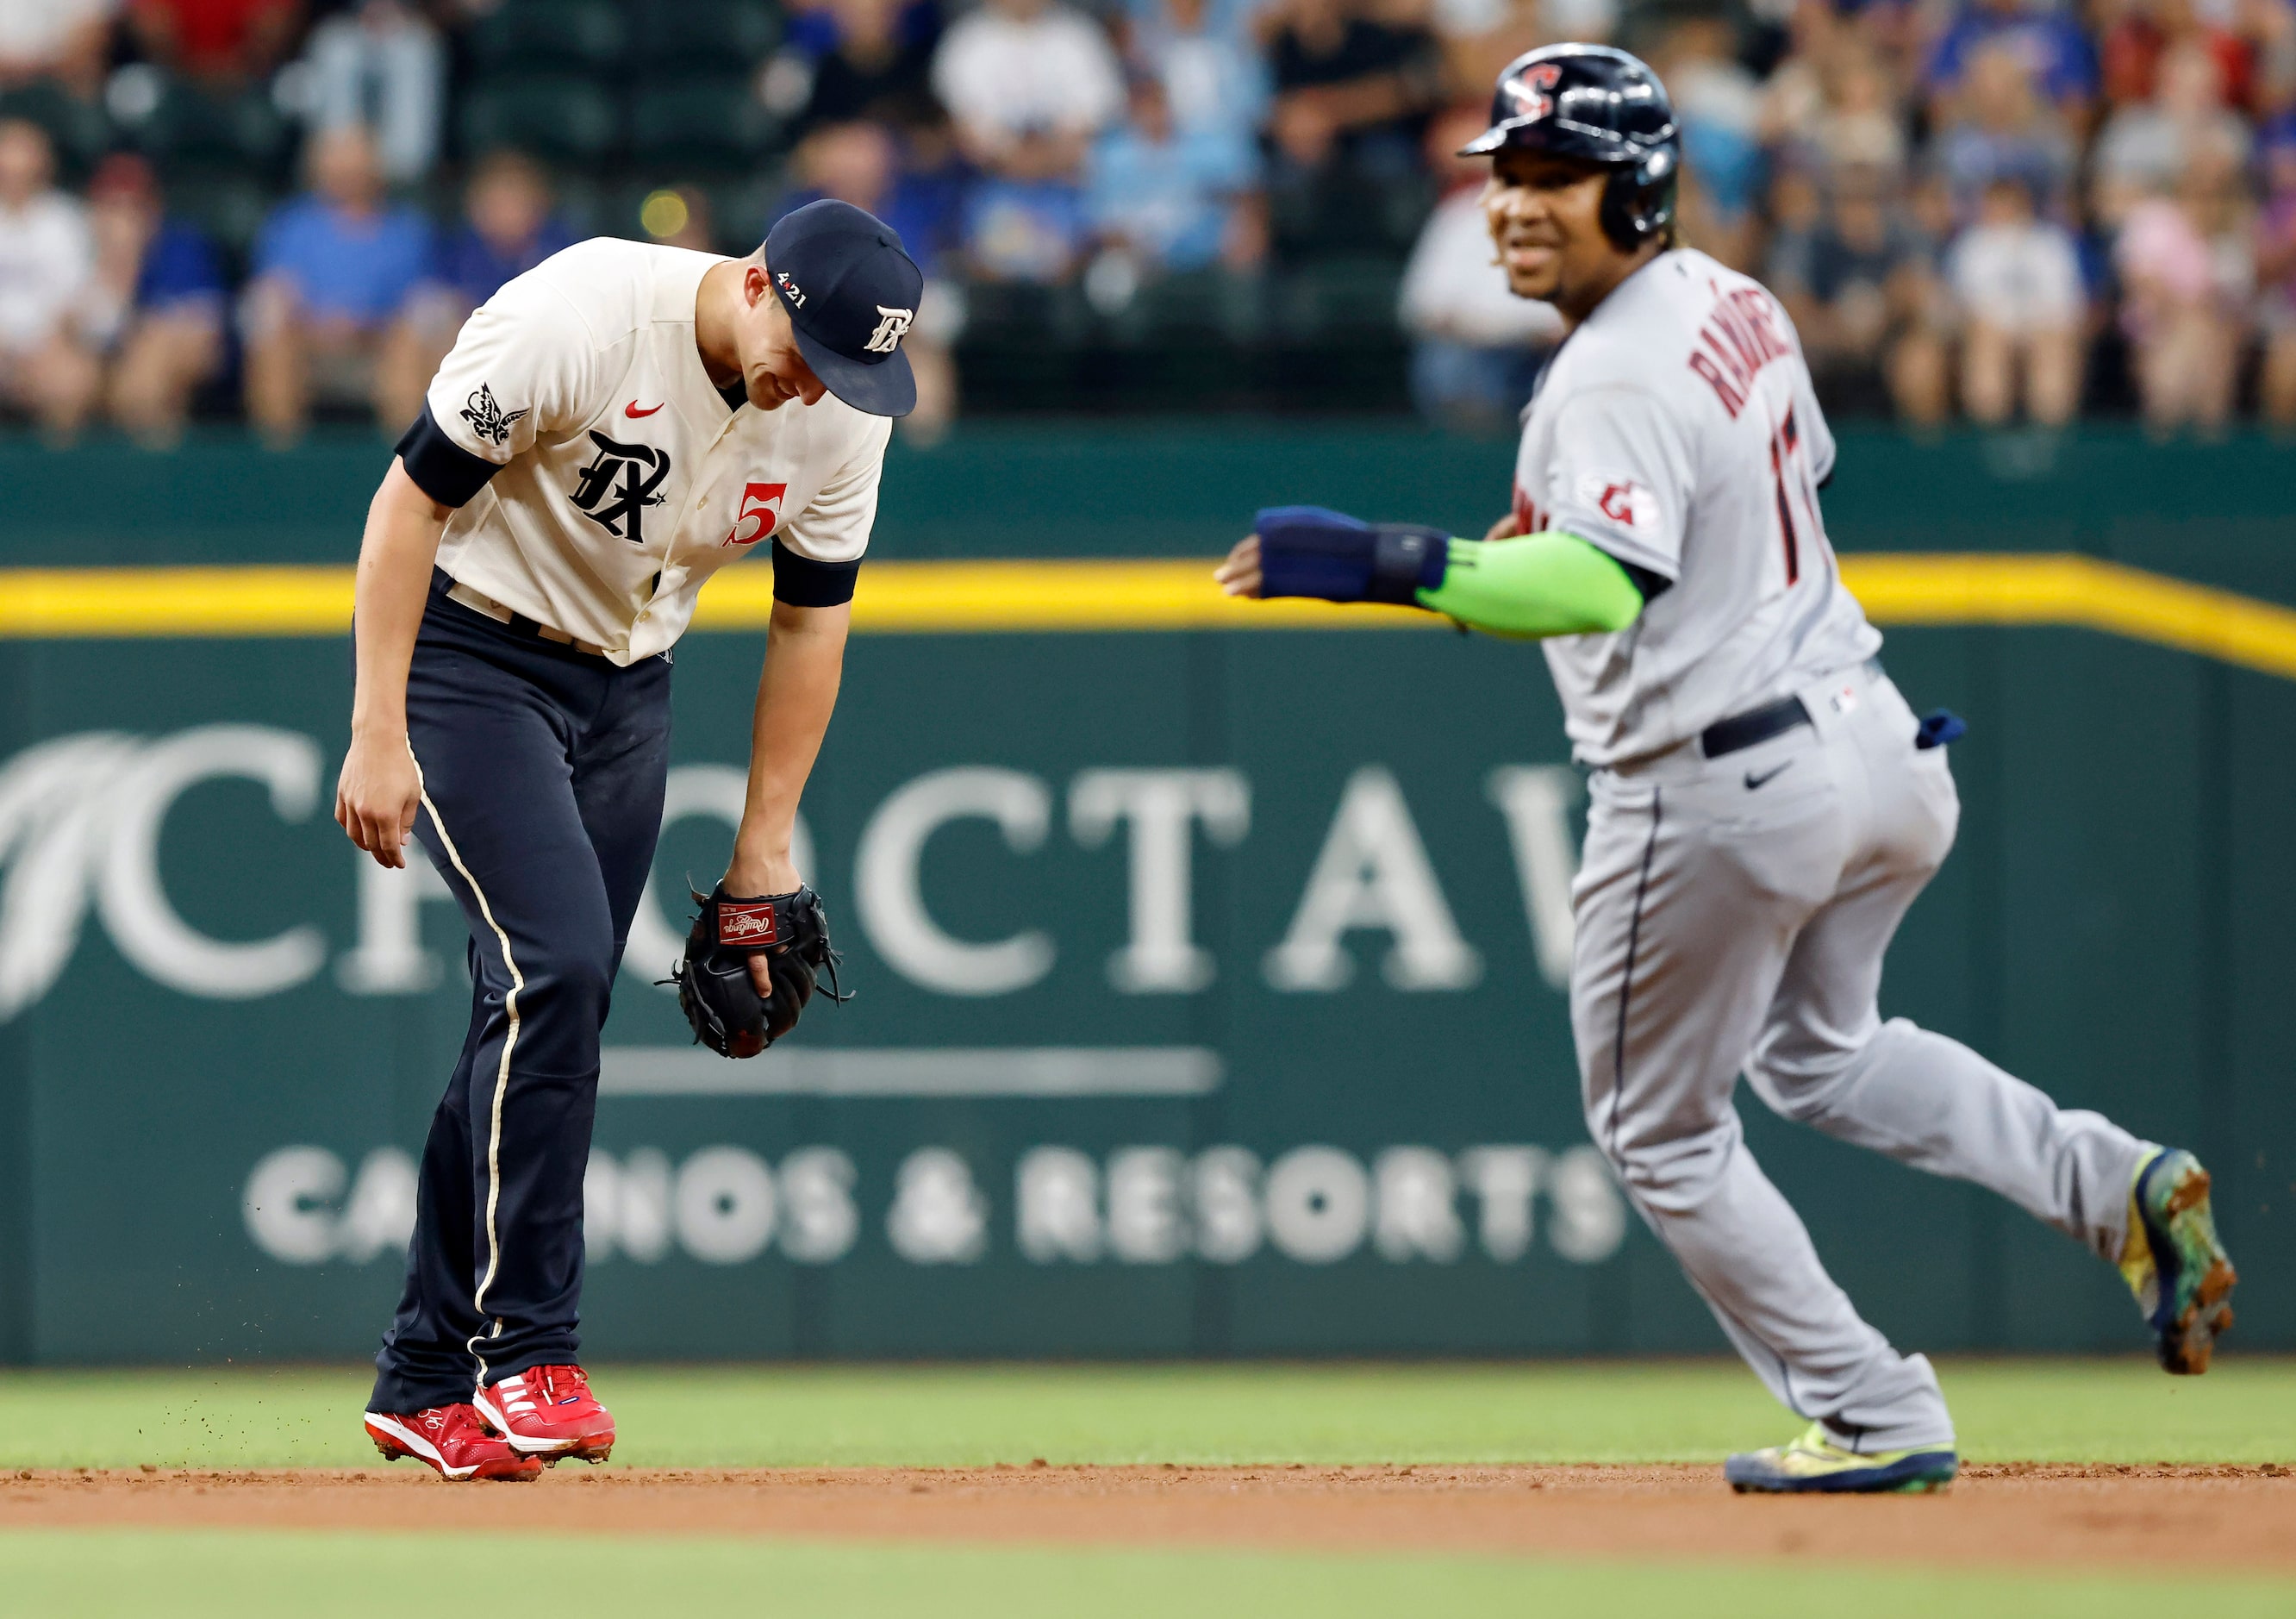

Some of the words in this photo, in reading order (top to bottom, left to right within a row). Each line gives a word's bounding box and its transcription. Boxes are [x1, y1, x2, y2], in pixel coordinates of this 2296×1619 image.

[1688, 278, 1793, 419] RAMÍRE
[721, 482, 788, 547] 5
[97, 722, 1582, 998] COCTA
[723, 916, 770, 936] Rawlings
[242, 1145, 858, 1266] CANOS
[886, 1147, 989, 1266] &
[1014, 1144, 1628, 1265] RESORTS
